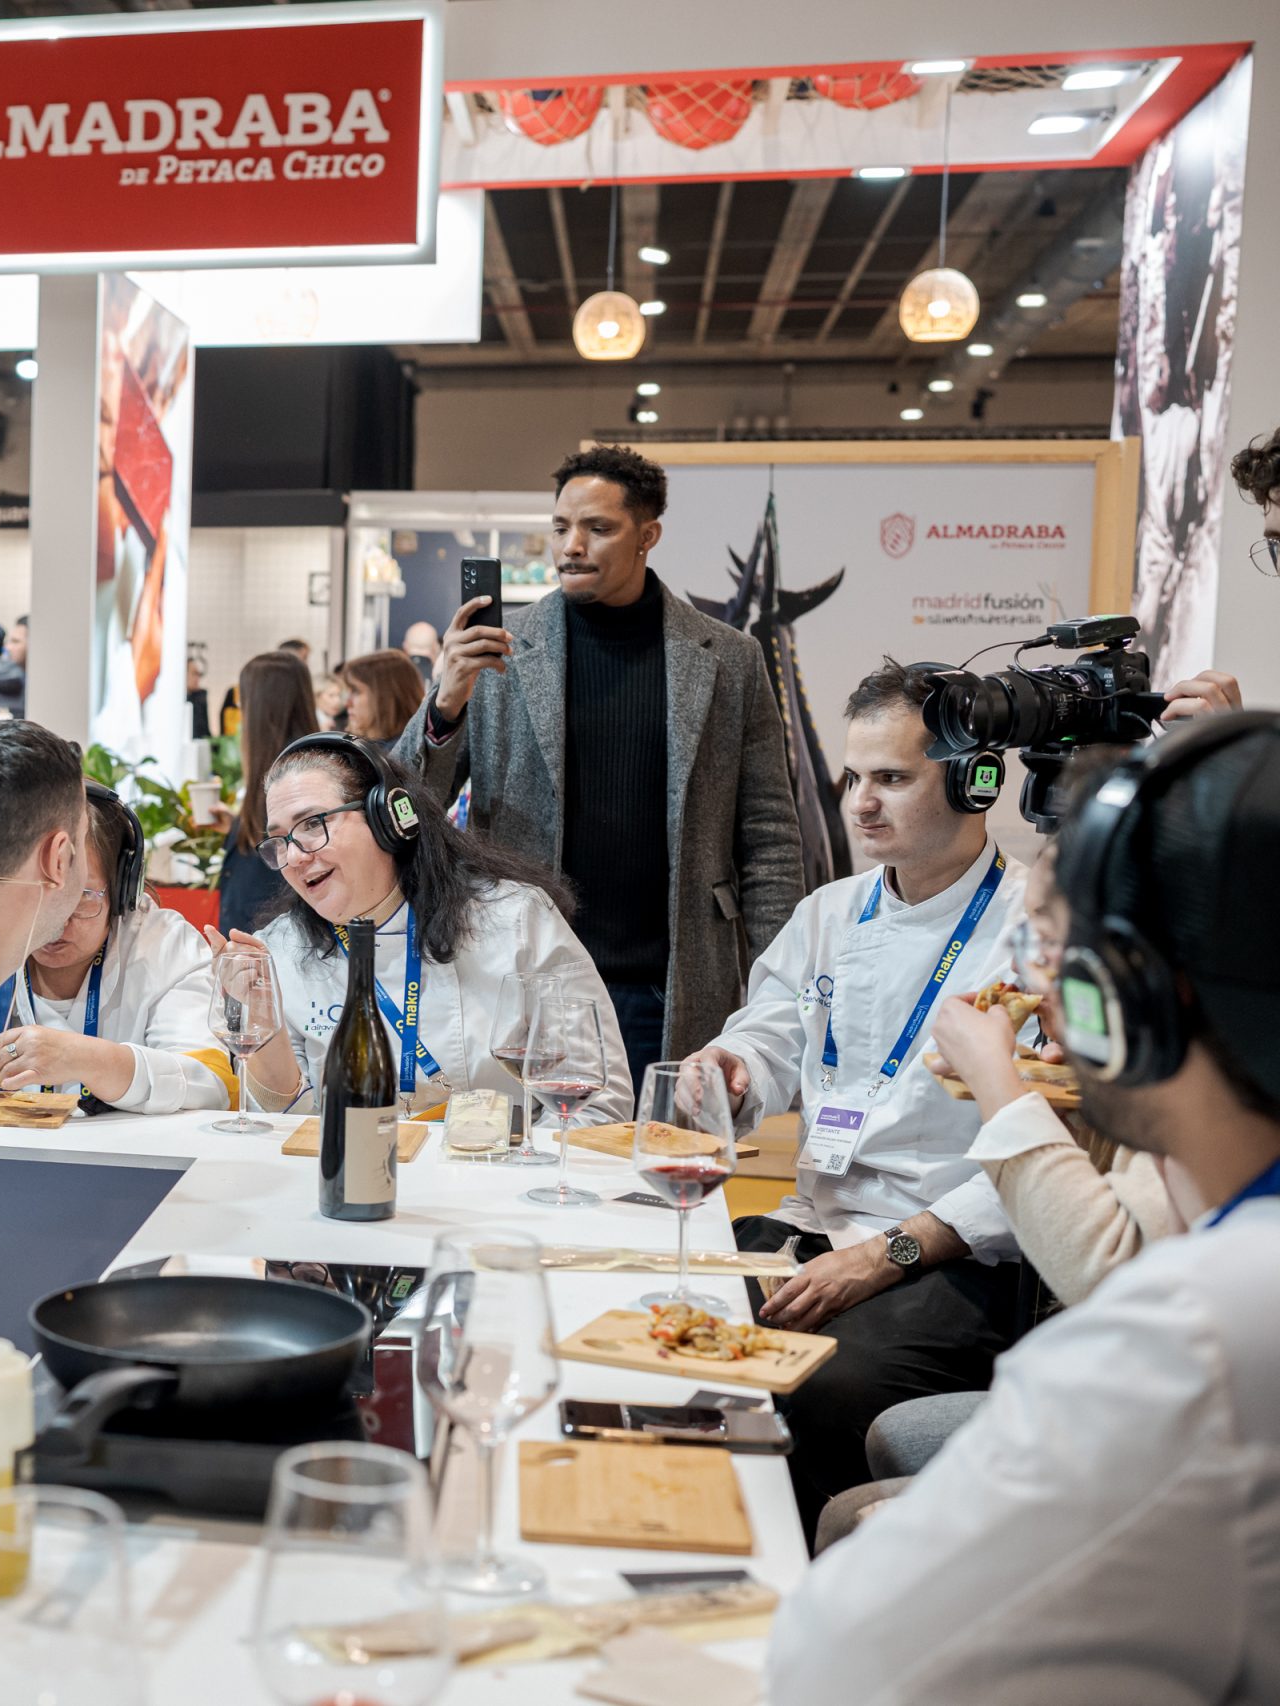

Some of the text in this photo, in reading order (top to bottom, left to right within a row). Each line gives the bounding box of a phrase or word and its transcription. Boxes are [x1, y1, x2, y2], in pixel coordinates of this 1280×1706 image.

[926, 524, 1066, 539] ALMADRABA
[933, 940, 962, 983] makro
[405, 981, 419, 1026] makro
